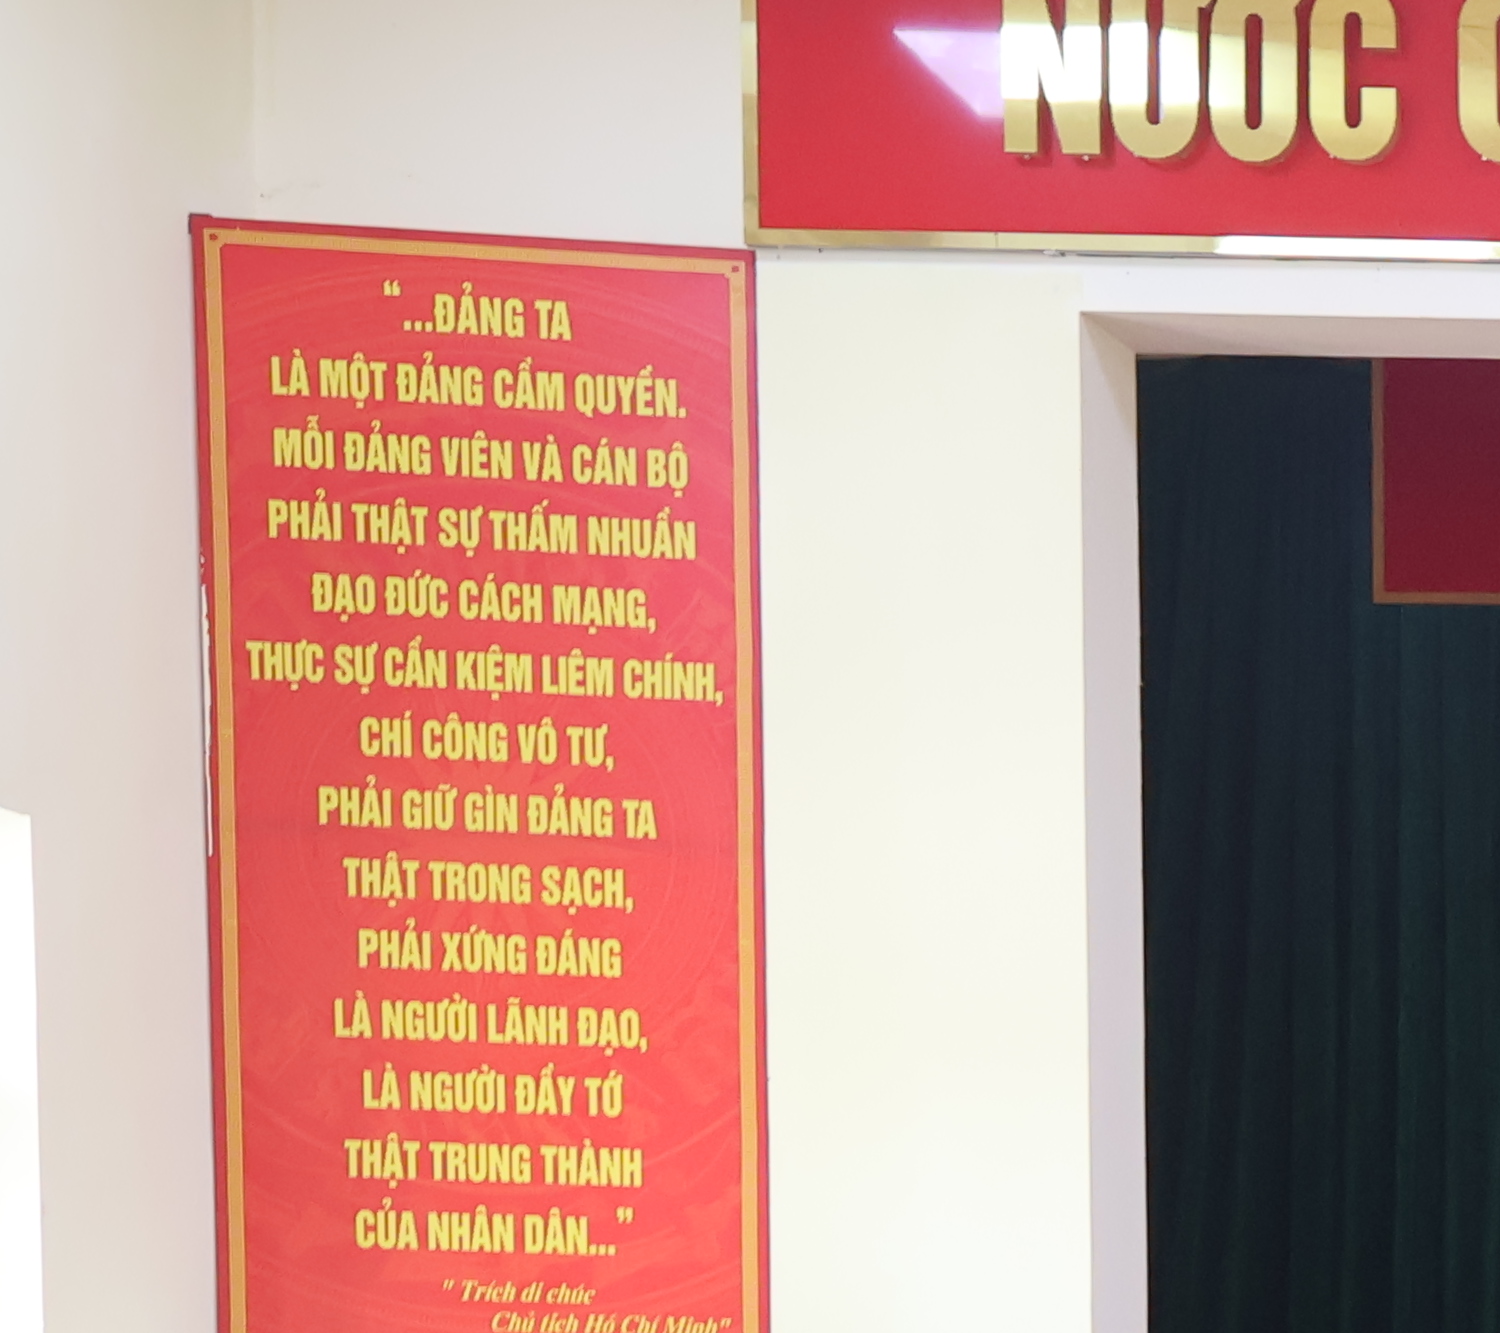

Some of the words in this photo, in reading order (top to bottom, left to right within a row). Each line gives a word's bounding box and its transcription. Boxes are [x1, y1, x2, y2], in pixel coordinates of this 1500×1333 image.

[535, 300, 571, 340] TA
[271, 349, 309, 396] LÀ
[320, 353, 387, 408] MỘT
[396, 352, 483, 406] ĐẢNG
[344, 420, 431, 474] ĐẢNG
[441, 431, 512, 479] VIÊN
[522, 435, 563, 482] VÀ
[573, 438, 636, 486] CÁN
[647, 442, 688, 497] BỘ
[312, 573, 375, 622] ĐẠO
[385, 570, 448, 618] ĐỨC
[459, 573, 542, 623] CÁCH
[553, 585, 655, 634] MẠNG,
[361, 711, 412, 757] CHÍ
[423, 713, 508, 762] CÔNG
[518, 717, 557, 764] VÔ
[566, 724, 613, 771] TƯ,
[343, 851, 419, 907] THẬT
[429, 862, 531, 904] TRONG
[541, 866, 633, 914] SẠCH,
[359, 918, 431, 970] PHẢI
[442, 925, 526, 974] XỨNG
[536, 929, 621, 977] ĐÁNG
[335, 991, 372, 1038] LÀ
[487, 997, 568, 1045] LÃNH
[577, 1008, 647, 1055] ĐẠO,
[344, 1133, 420, 1188] THẬT
[429, 1142, 531, 1183] TRUNG
[541, 1139, 642, 1187] THÀNH
[356, 1198, 418, 1250] CỦA
[428, 1205, 514, 1252] NHÂN
